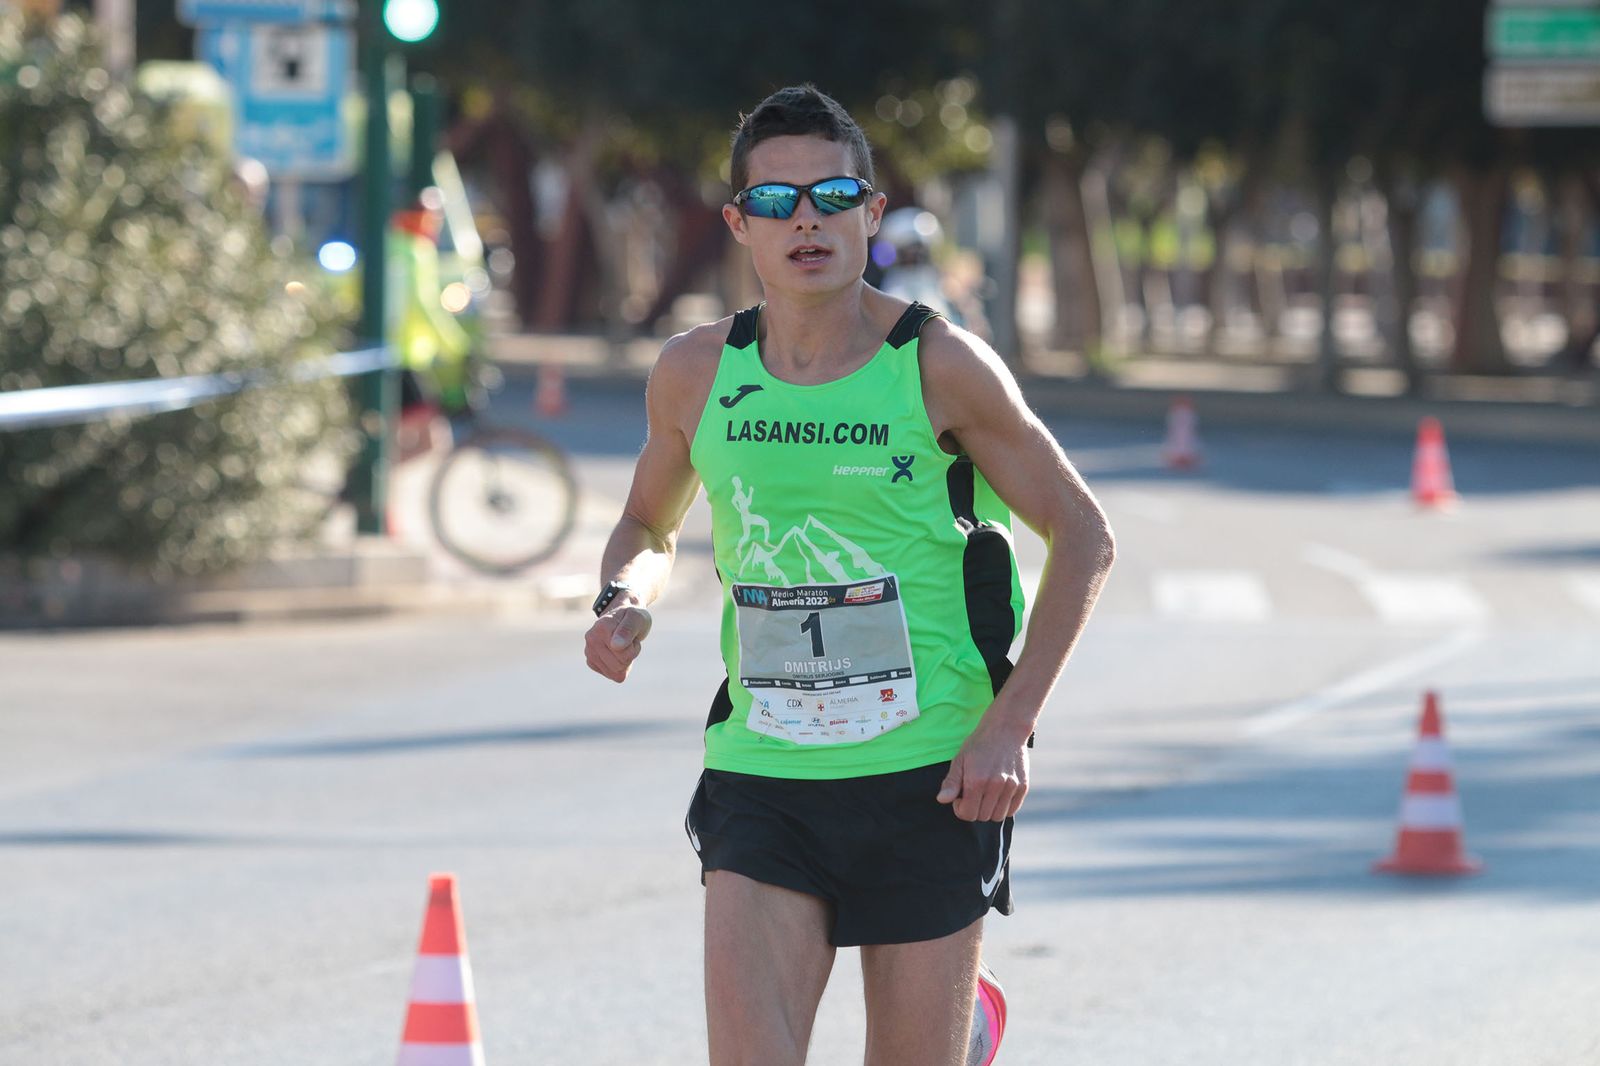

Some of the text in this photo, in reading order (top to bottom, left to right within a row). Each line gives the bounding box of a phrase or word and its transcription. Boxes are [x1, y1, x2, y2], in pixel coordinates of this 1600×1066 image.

[726, 420, 889, 446] LASANSI.COM
[771, 588, 829, 599] Medio Maratón
[771, 597, 805, 607] Almería
[805, 596, 829, 606] 2022
[799, 610, 826, 659] 1
[784, 657, 852, 674] DMITRIJS
[786, 698, 803, 708] CDX
